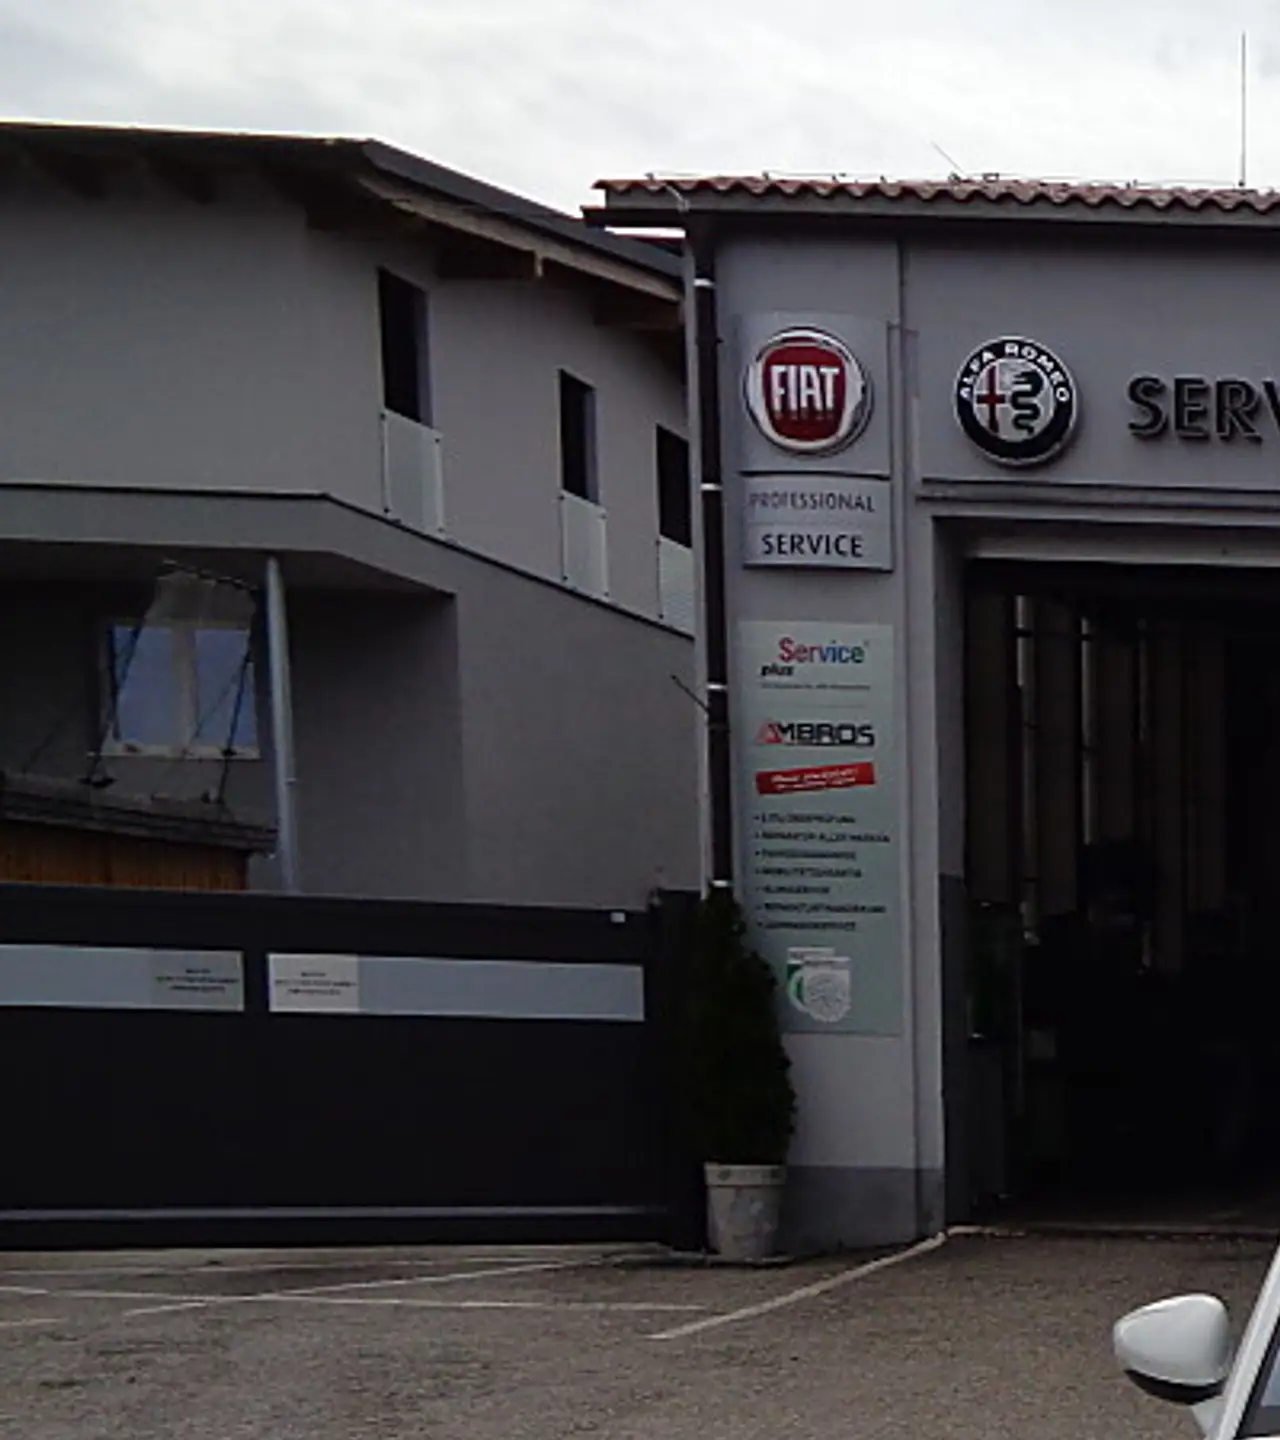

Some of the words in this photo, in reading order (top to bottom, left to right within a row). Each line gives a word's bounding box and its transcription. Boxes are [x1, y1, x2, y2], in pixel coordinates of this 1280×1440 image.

[960, 351, 996, 399] ALFA
[1005, 342, 1070, 402] ROMEO
[769, 364, 840, 411] FIAT
[750, 490, 875, 513] PROFESSIONAL
[761, 533, 864, 557] SERVICE
[779, 637, 866, 664] Service
[756, 720, 875, 747] AMBROS
